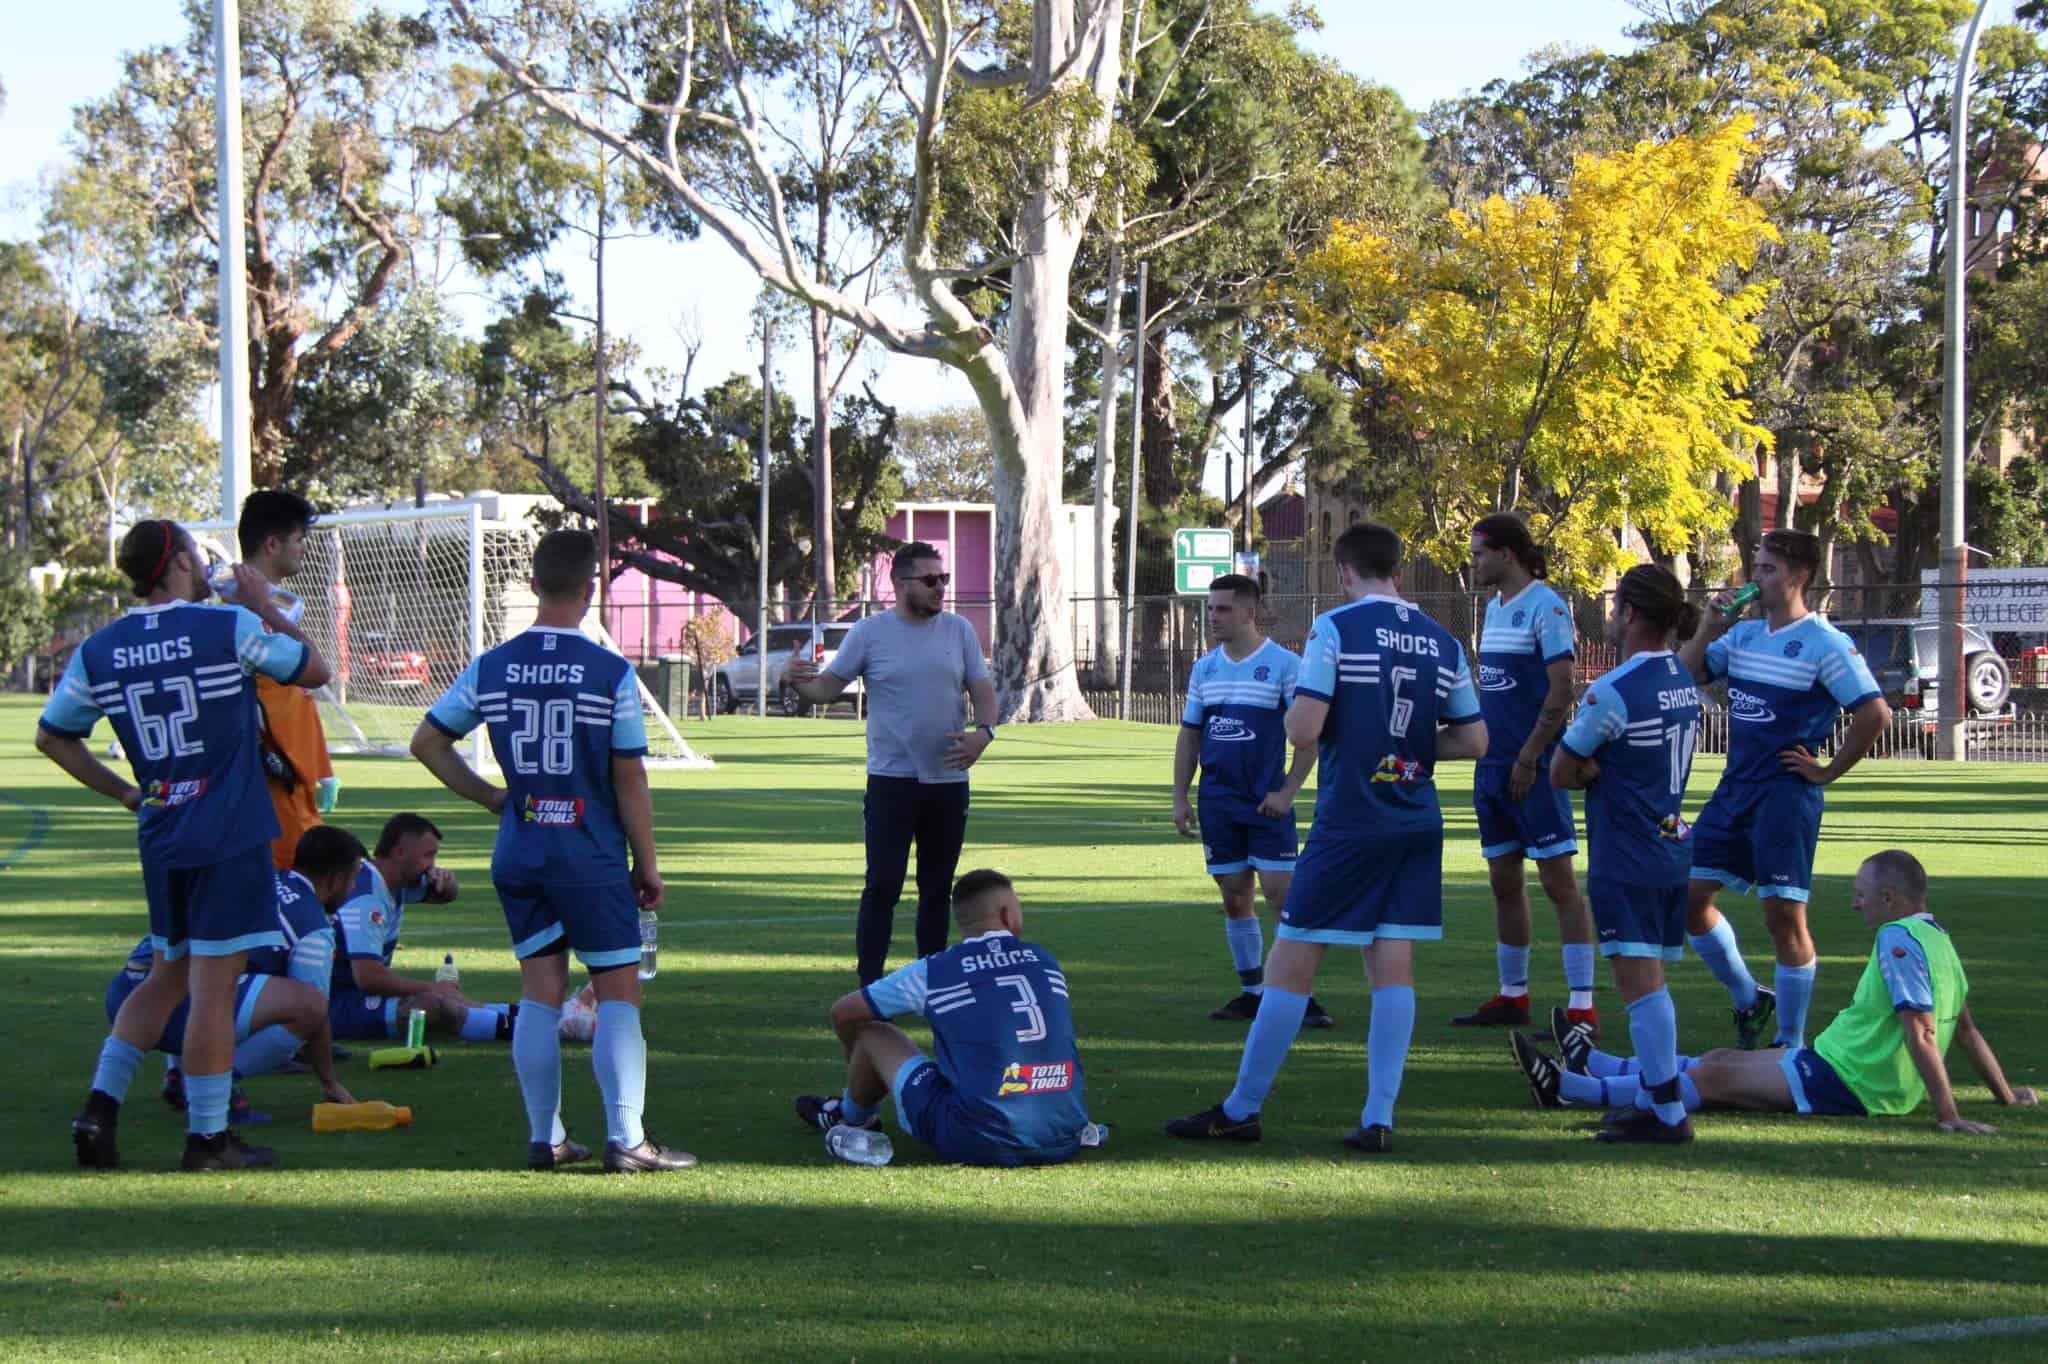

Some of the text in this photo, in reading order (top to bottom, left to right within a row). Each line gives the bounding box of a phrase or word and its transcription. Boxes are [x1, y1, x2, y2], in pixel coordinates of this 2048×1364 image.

[113, 636, 193, 669] SHOCS
[1376, 628, 1440, 657] SHOCS
[505, 663, 585, 685] SHOCS
[1389, 666, 1417, 738] 6
[125, 675, 205, 760] 62
[511, 698, 574, 775] 28
[536, 800, 576, 812] TOTAL
[536, 812, 576, 824] TOOLS
[961, 949, 1040, 973] SHOCS
[994, 974, 1047, 1043] 3
[1031, 1063, 1067, 1077] TOTAL
[1031, 1076, 1068, 1090] TOOLS
